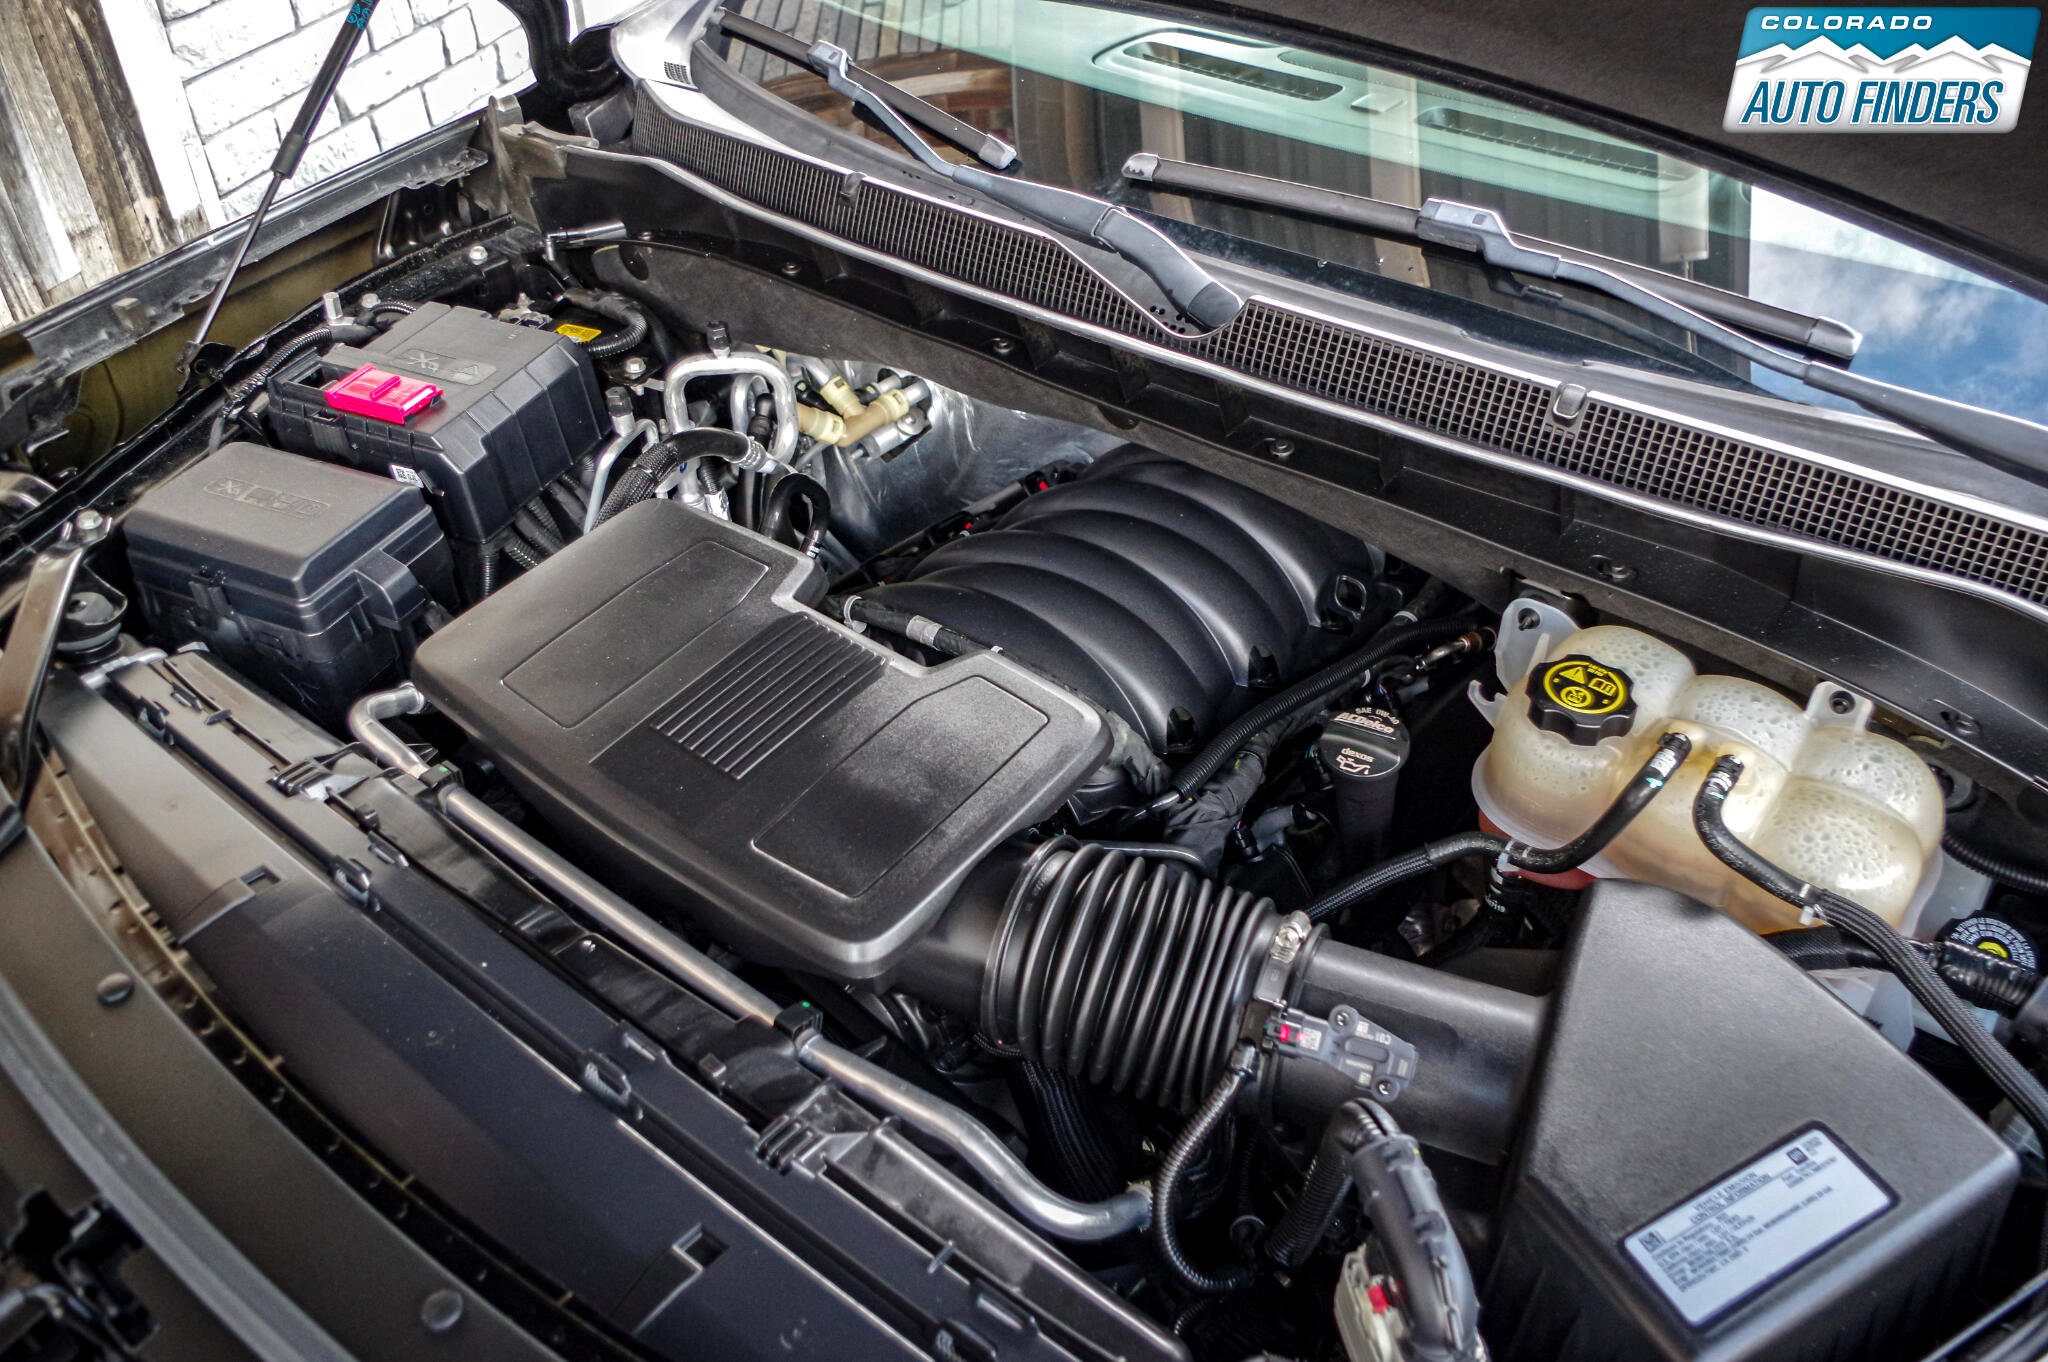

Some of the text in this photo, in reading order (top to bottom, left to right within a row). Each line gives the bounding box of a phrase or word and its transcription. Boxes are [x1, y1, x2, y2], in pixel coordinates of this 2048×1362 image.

[1335, 712, 1395, 734] ACDelco
[1375, 708, 1400, 725] 0W-40
[1341, 747, 1375, 763] dexos
[1722, 1170, 1757, 1193] EMISSION
[1689, 1200, 1725, 1224] CONTROL
[1722, 1172, 1772, 1204] INFORMATION
